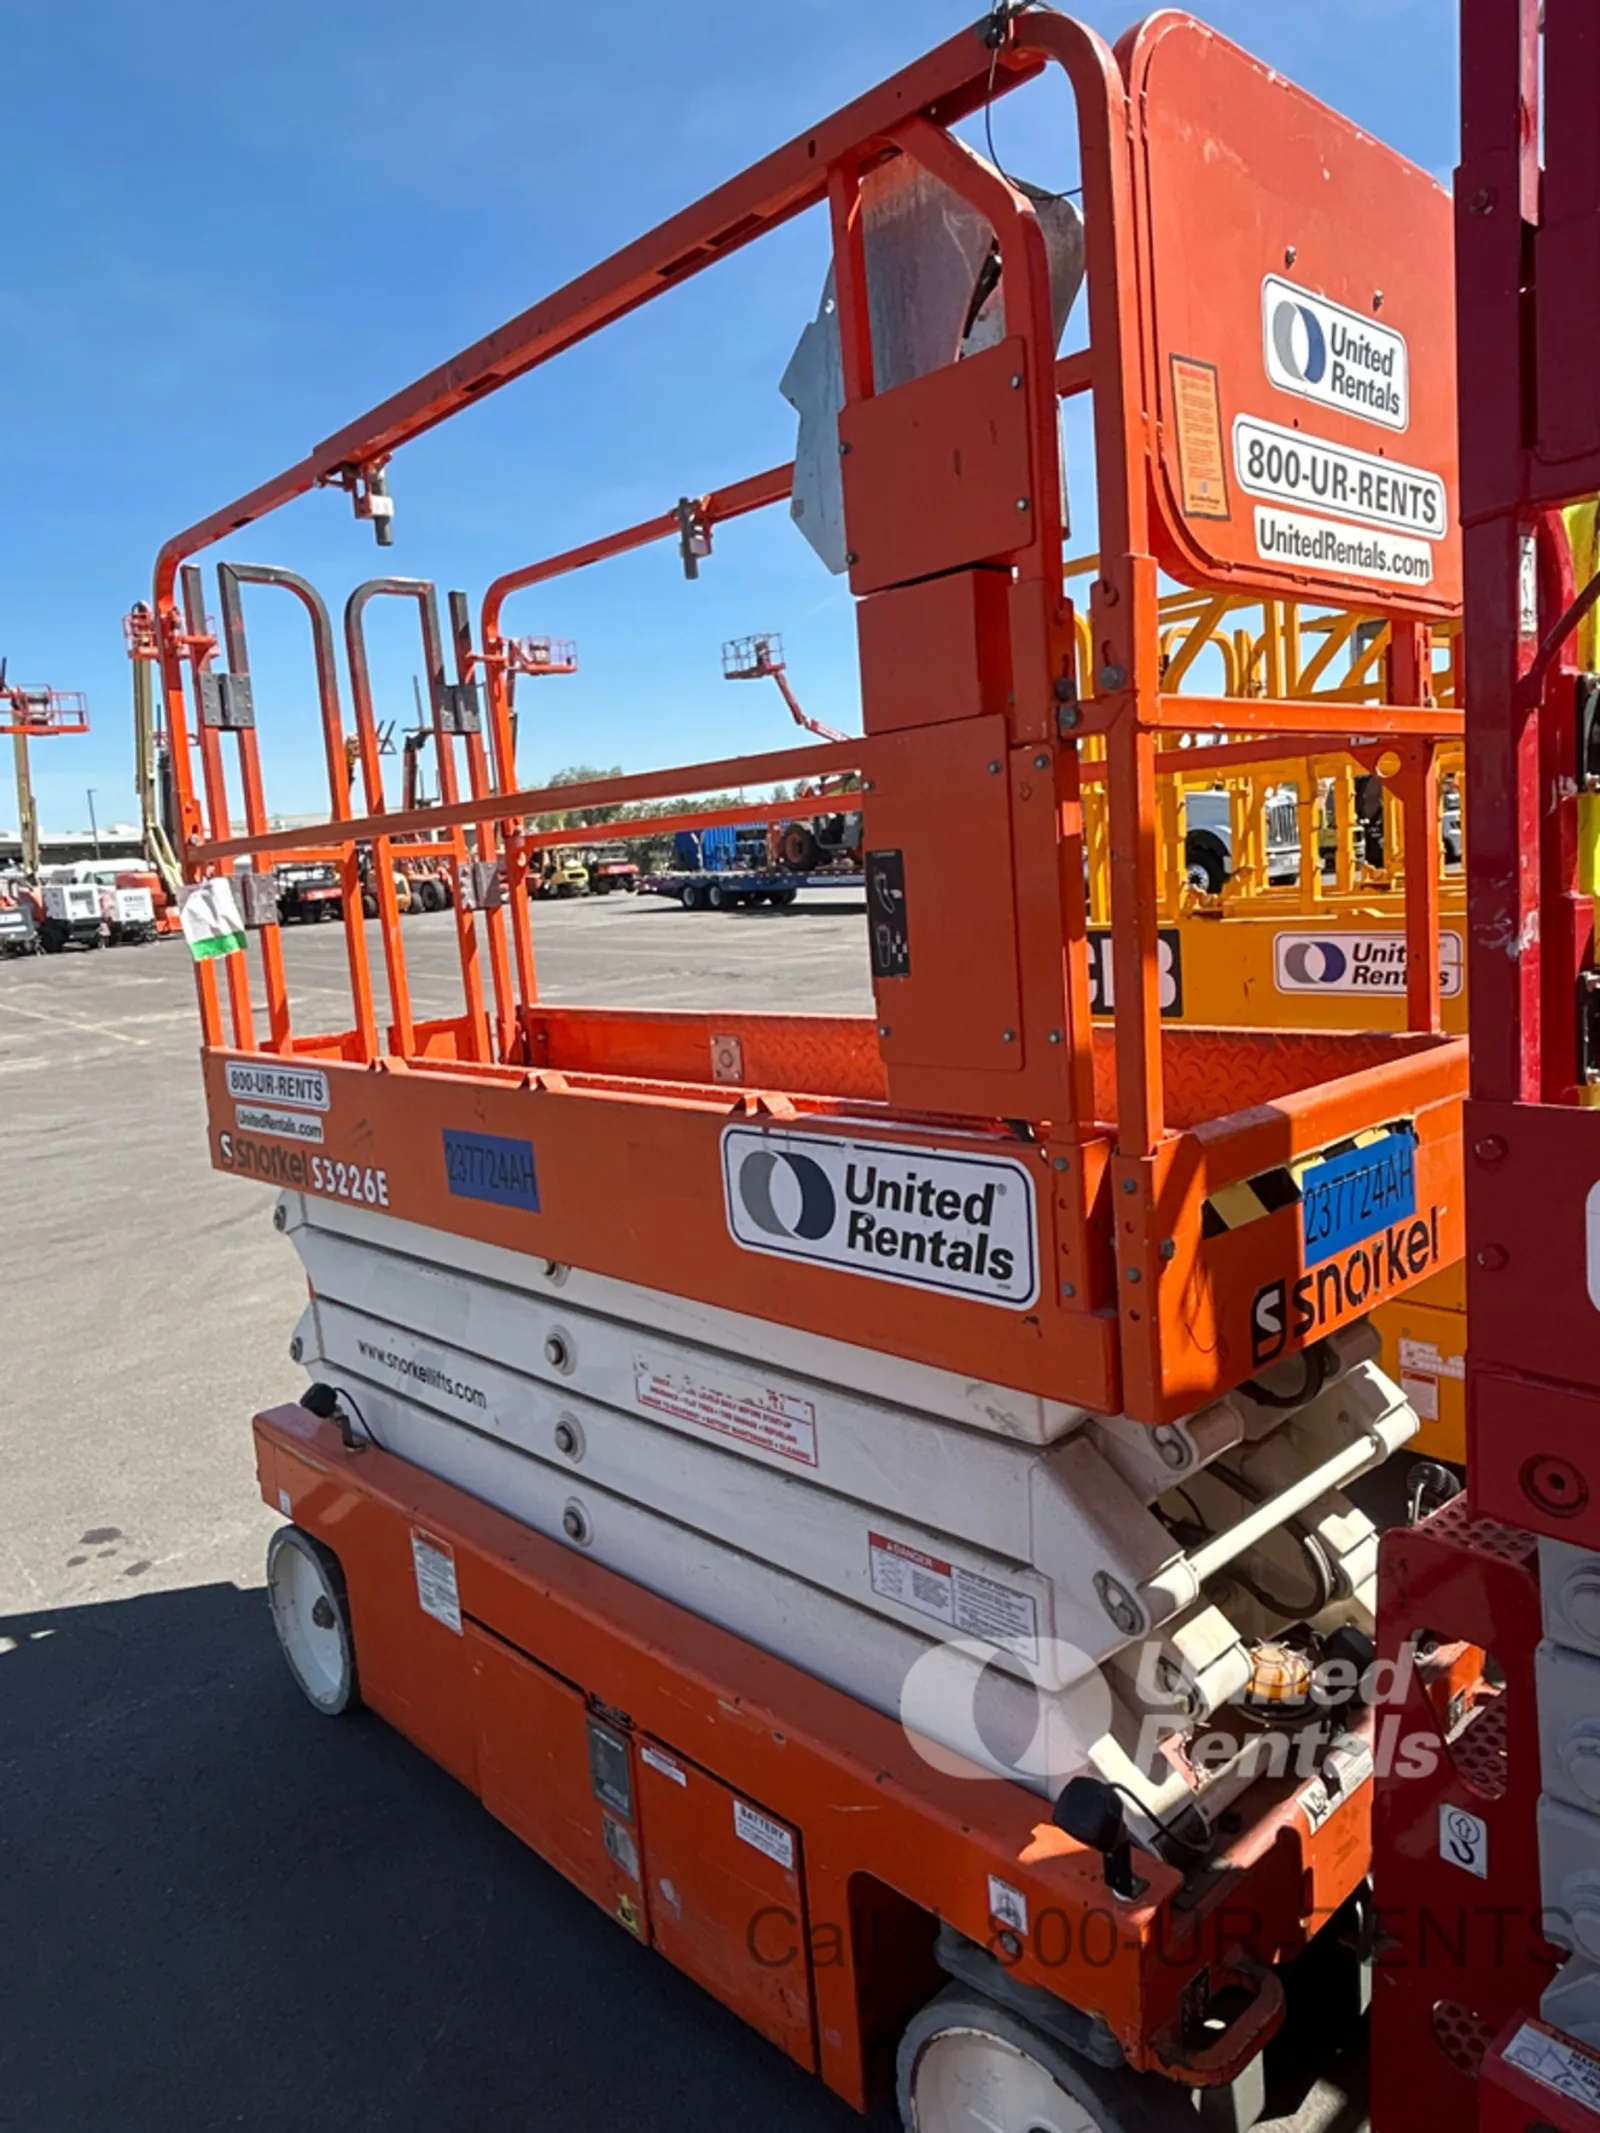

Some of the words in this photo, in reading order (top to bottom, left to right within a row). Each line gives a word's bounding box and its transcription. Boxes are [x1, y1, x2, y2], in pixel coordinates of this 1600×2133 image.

[1330, 322, 1395, 378] United
[1331, 360, 1400, 416] Rentals
[1247, 438, 1437, 525] 800-UR-RENTS
[1260, 518, 1430, 579] UnitedRentals.com
[1351, 964, 1449, 988] Rents
[1352, 942, 1406, 964] Unit
[231, 1069, 324, 1102] 800-UR-RENTS
[238, 1109, 322, 1138] UnitedRentals.com
[236, 1138, 310, 1187] snorkel
[312, 1155, 391, 1207] S3226E
[844, 1163, 996, 1227] United
[846, 1210, 1015, 1281] Rentals
[1293, 1205, 1439, 1338] snorkel
[357, 1338, 487, 1410] www.snorkellifts.com
